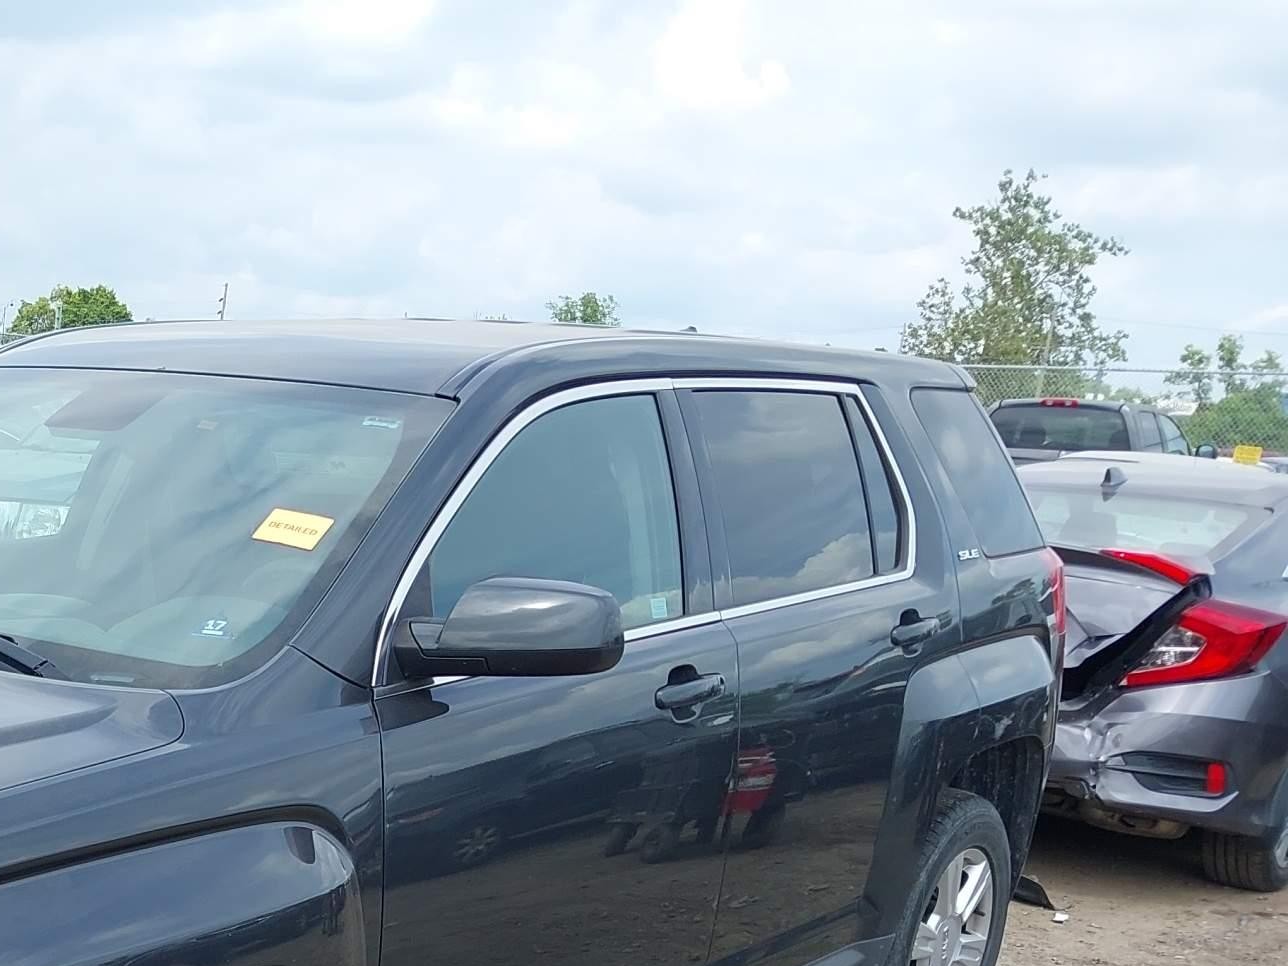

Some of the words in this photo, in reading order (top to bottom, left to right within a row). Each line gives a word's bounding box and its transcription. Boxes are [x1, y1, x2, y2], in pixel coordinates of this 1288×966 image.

[267, 520, 318, 536] DETAILED
[958, 548, 980, 561] SLE
[204, 619, 227, 631] 17
